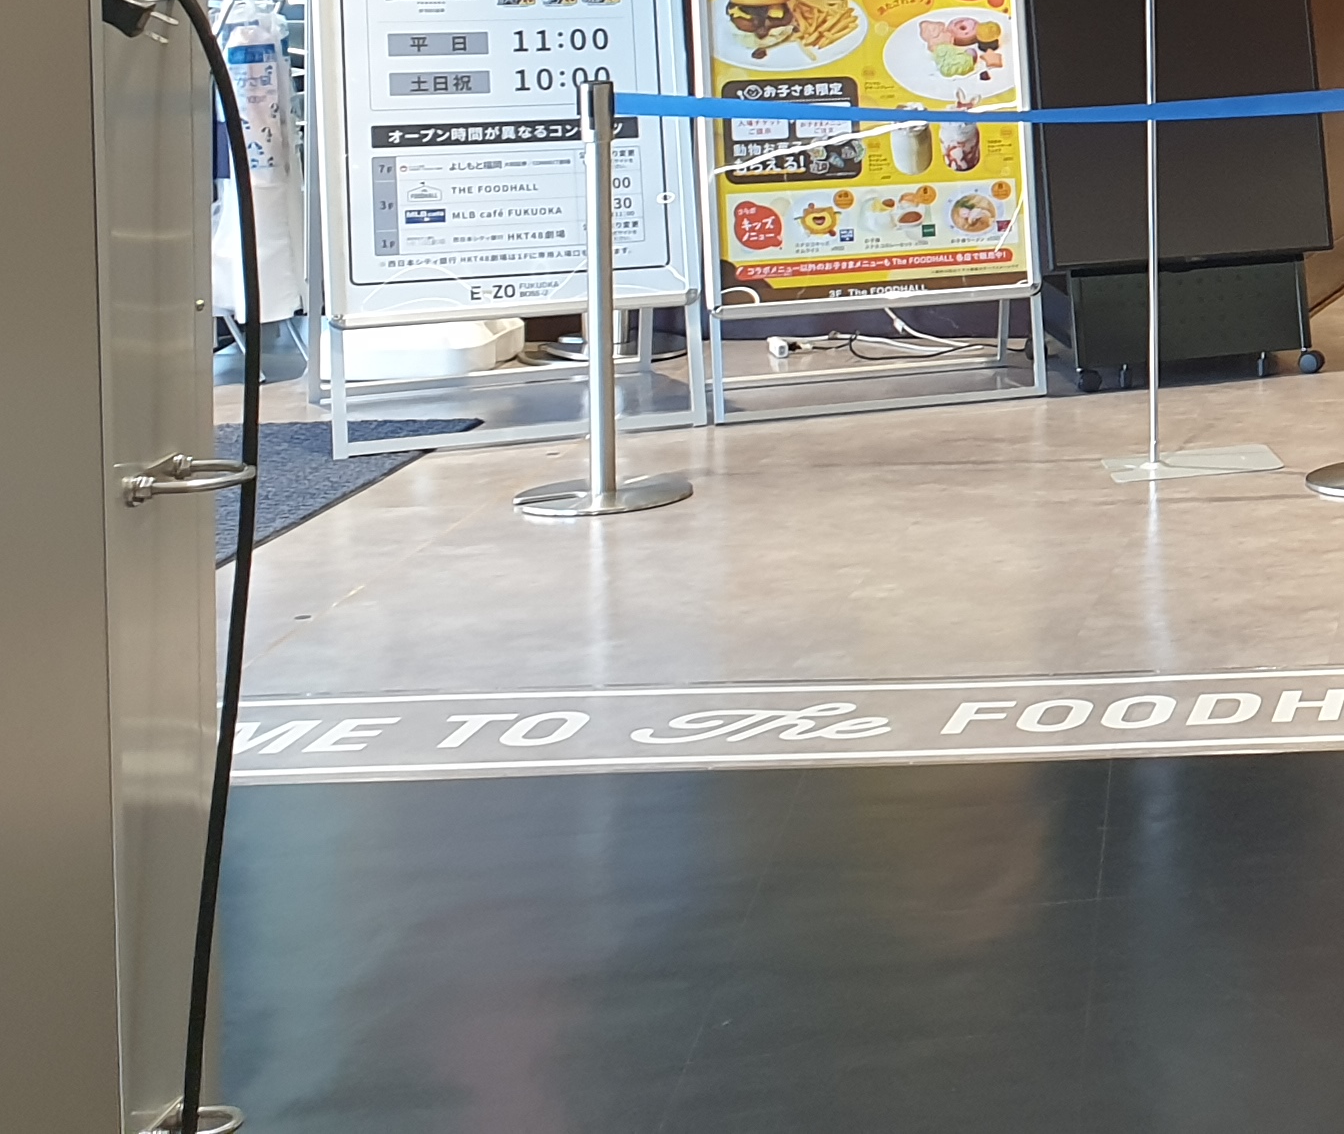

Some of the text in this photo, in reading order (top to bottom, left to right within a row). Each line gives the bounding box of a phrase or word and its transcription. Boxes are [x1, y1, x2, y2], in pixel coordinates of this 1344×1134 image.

[512, 28, 609, 52] 11:00
[410, 74, 473, 93] 土日祝
[763, 82, 843, 98] お子さま限定
[378, 164, 393, 174] 7F
[451, 183, 539, 194] THE FOODHALL
[379, 200, 394, 210] 3F
[452, 206, 563, 220] MLB café FUKUOKA
[741, 216, 776, 230] キッズ
[507, 229, 566, 242] HKT48劇場
[381, 239, 395, 249] 1F
[892, 256, 907, 265] The
[908, 254, 954, 264] FOODHALL
[828, 288, 842, 298] 3F
[847, 287, 868, 297] The
[436, 711, 591, 749] TO
[631, 701, 893, 743] The
